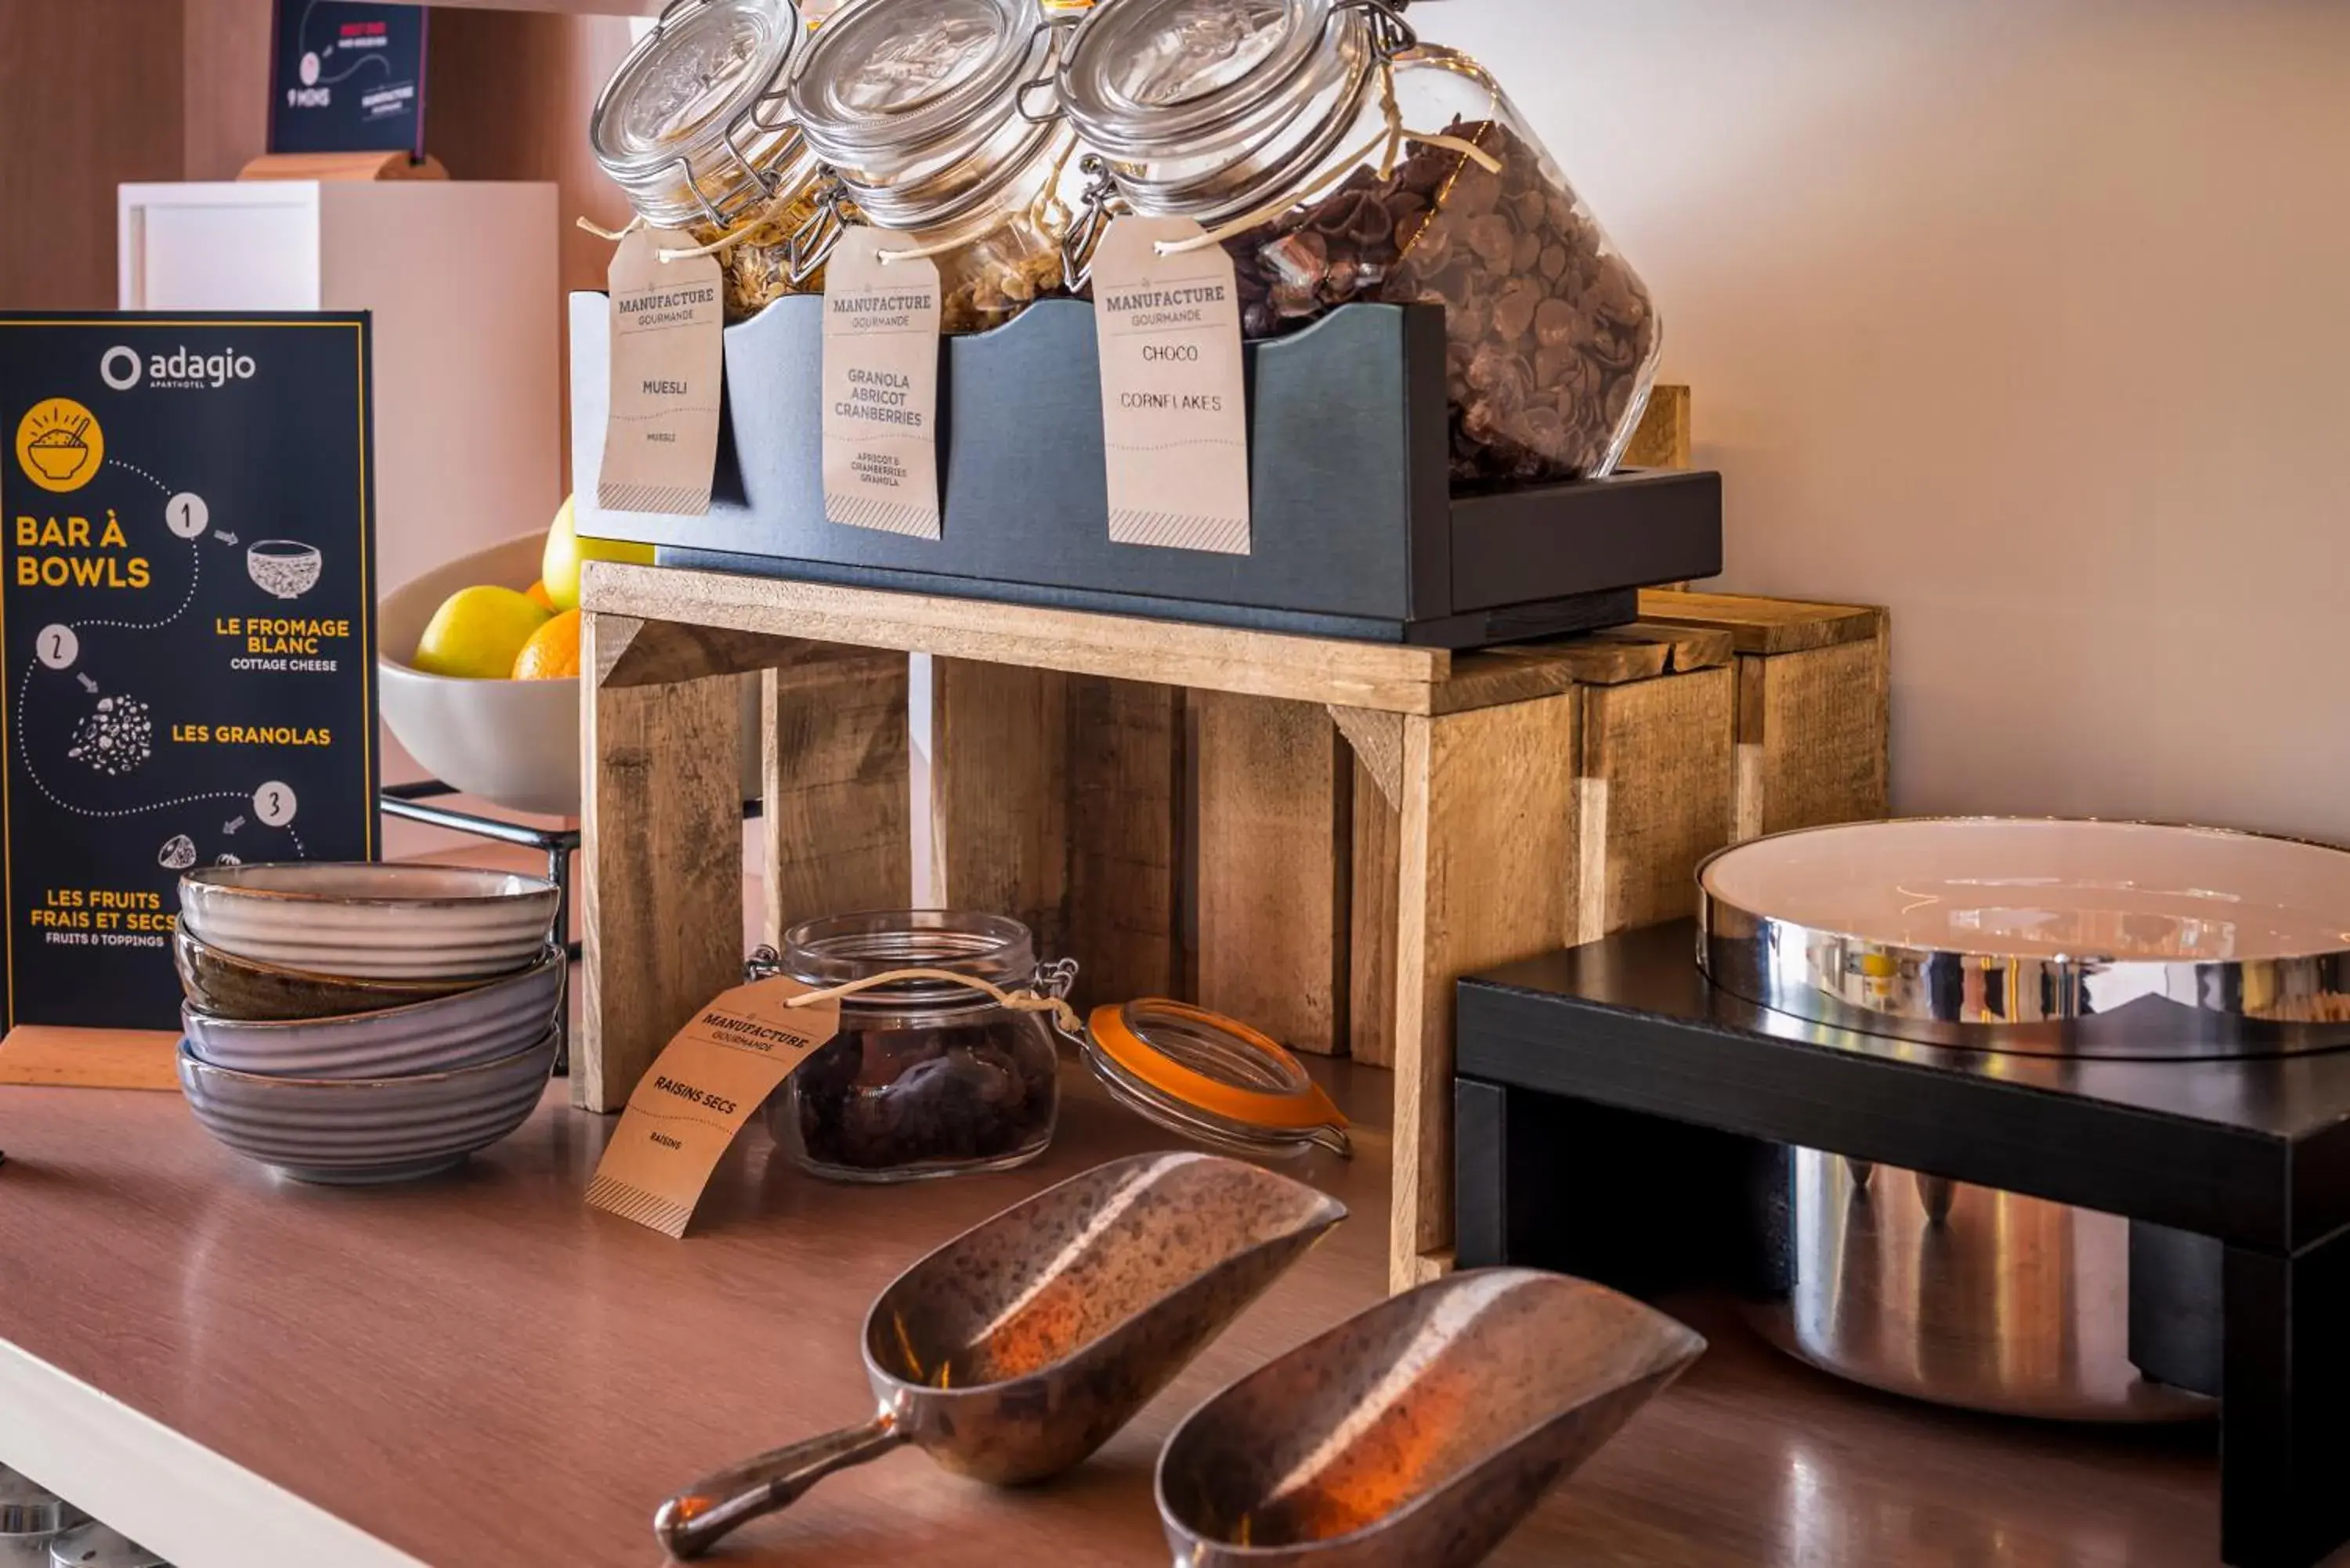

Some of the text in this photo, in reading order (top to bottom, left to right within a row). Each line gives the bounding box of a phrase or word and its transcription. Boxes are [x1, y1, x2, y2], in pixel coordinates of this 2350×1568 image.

[619, 288, 714, 313] MANUFACTURE
[833, 294, 931, 313] MANUFACTURE
[1106, 286, 1224, 312] MANUFACTURE
[638, 309, 693, 326] GOURMANDE
[852, 316, 909, 328] GOURMANDE
[1132, 309, 1202, 327] GOURMANDE
[1143, 345, 1198, 363] CHOCO
[150, 345, 255, 388] adagio
[643, 381, 687, 394] MUESLI
[848, 369, 909, 388] GRANOLA
[851, 387, 906, 407] ABRICOT
[1121, 392, 1221, 411] CORNFLAKES
[835, 402, 922, 427] CRANBERRIES
[181, 504, 190, 528] 1
[16, 509, 127, 547] BAR À
[17, 557, 150, 587] BOWLS
[217, 619, 349, 637] LE FROMAGE
[52, 634, 62, 659] 2
[248, 638, 318, 654] BLANC
[230, 658, 337, 672] COTTAGE CHEESE
[172, 725, 331, 745] LES GRANOLAS
[268, 792, 280, 817] 3
[47, 889, 160, 909] LES FRUITS
[31, 909, 176, 930] FRAIS ET SECS
[45, 932, 89, 945] FRUITS
[102, 934, 164, 947] TOPPINGS
[702, 1013, 809, 1049] MANUFACTURE
[712, 1031, 773, 1052] GOURMANDE
[653, 1075, 736, 1115] RAISINS SECS
